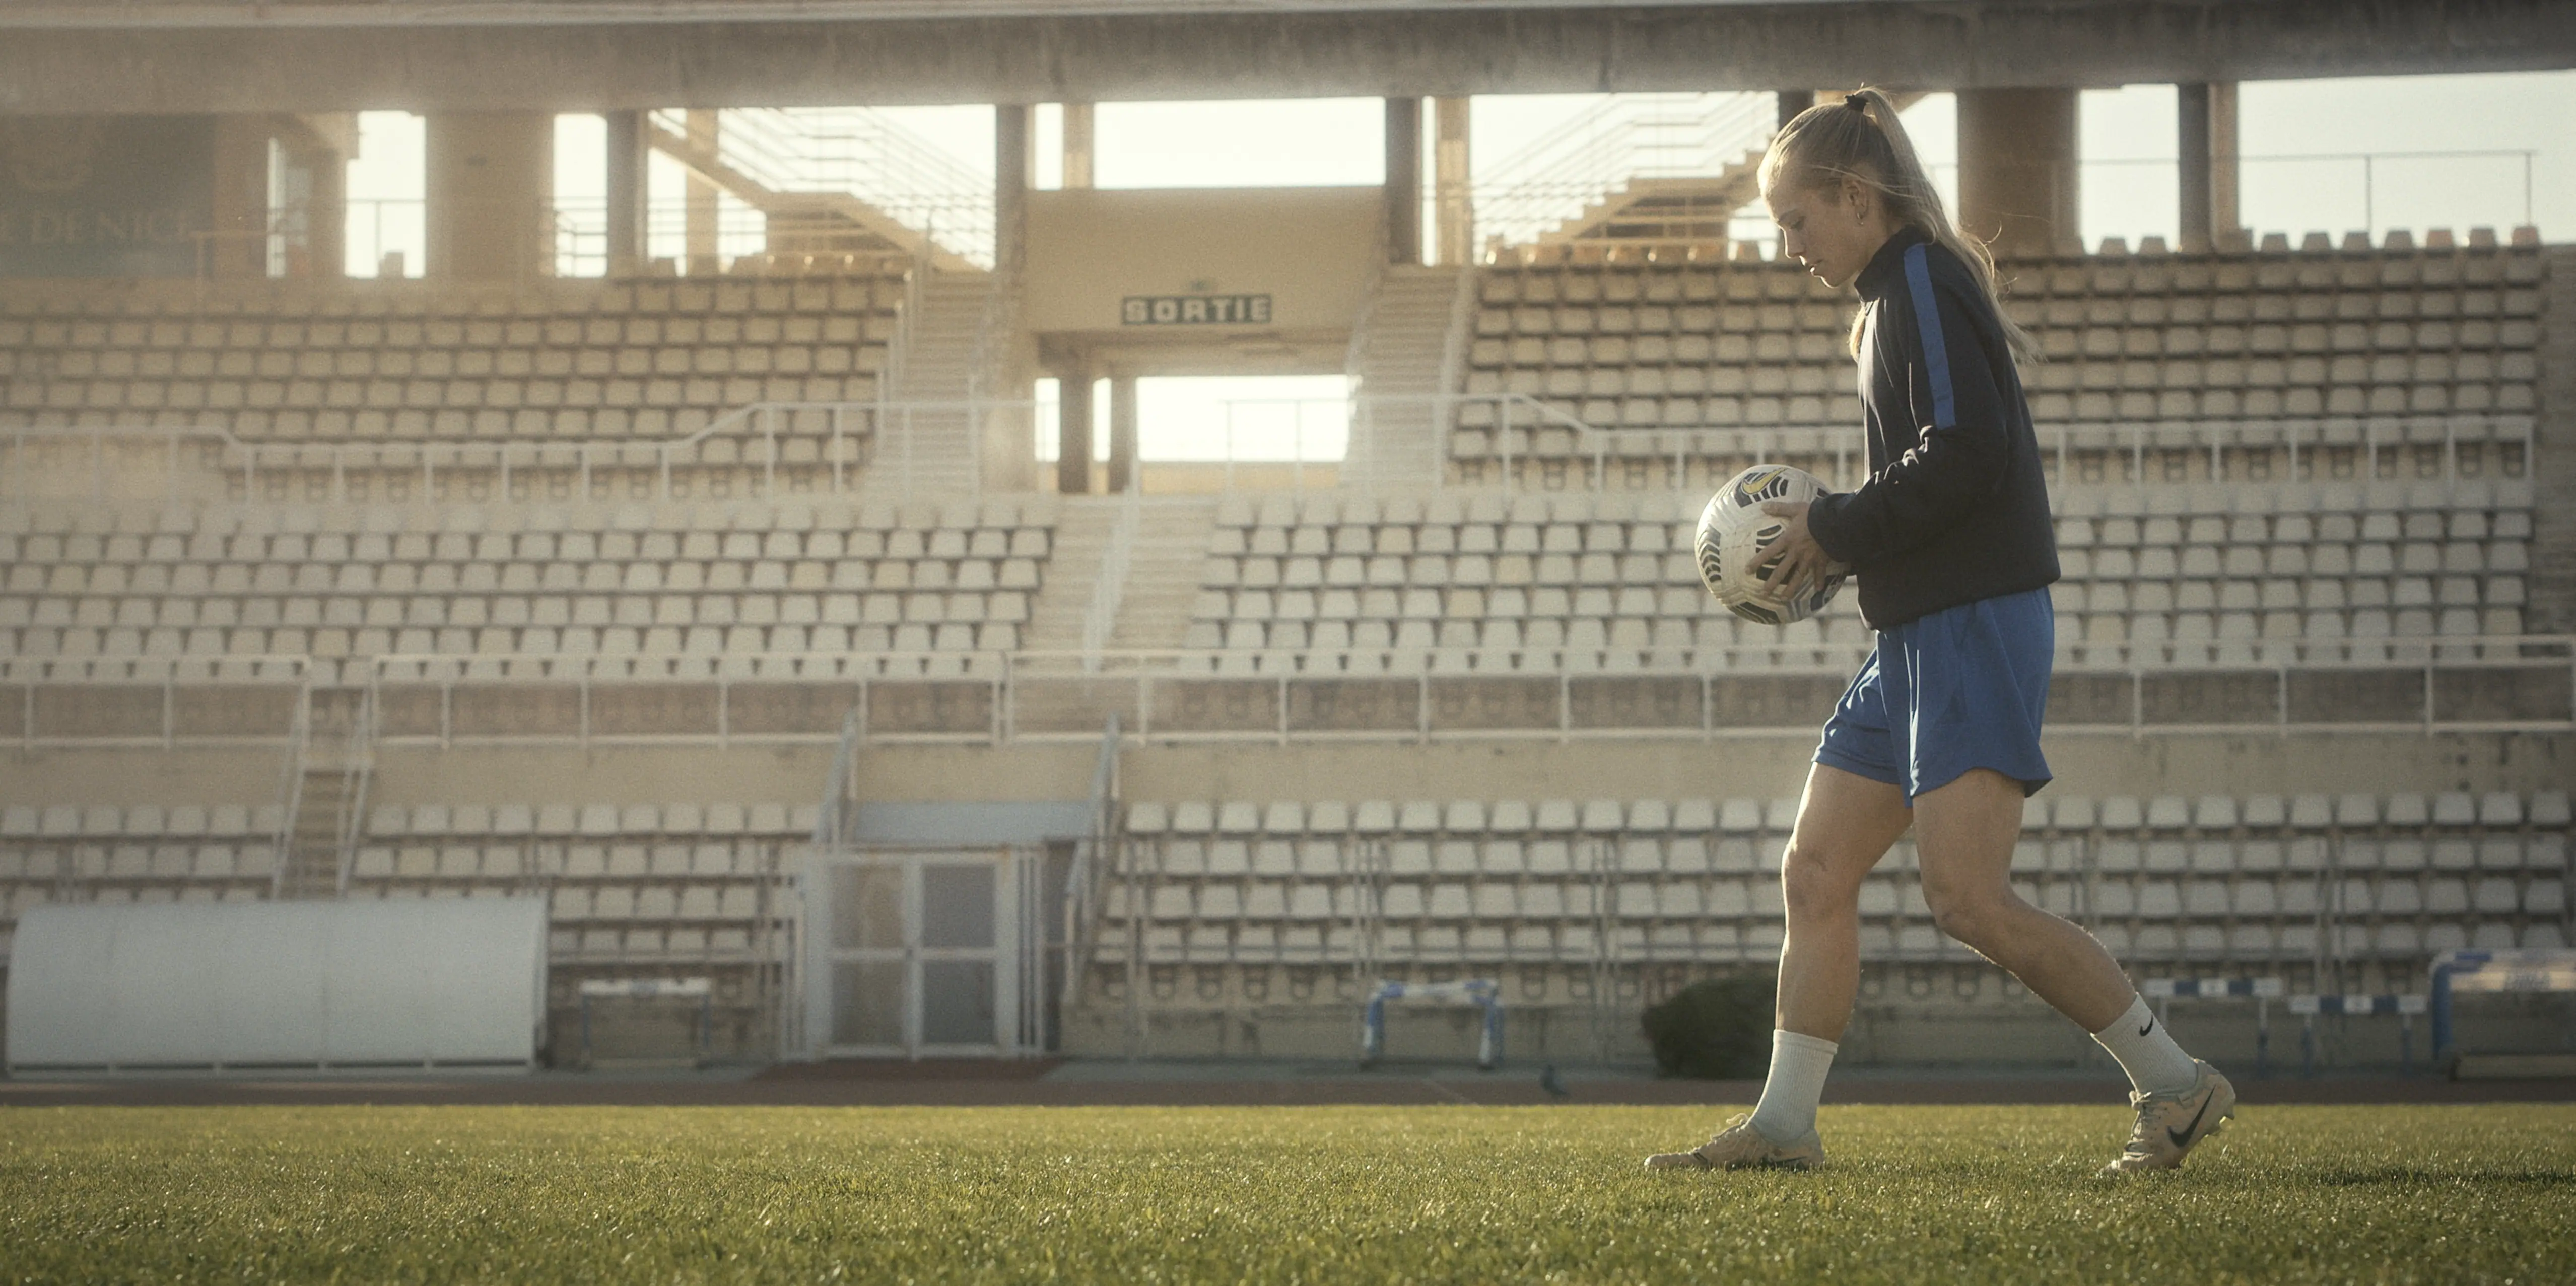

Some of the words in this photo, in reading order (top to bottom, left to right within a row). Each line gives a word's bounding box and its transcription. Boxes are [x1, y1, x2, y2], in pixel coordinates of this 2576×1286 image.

[32, 209, 84, 244] DE
[98, 208, 194, 242] NICE
[1124, 297, 1269, 322] SORTIE
